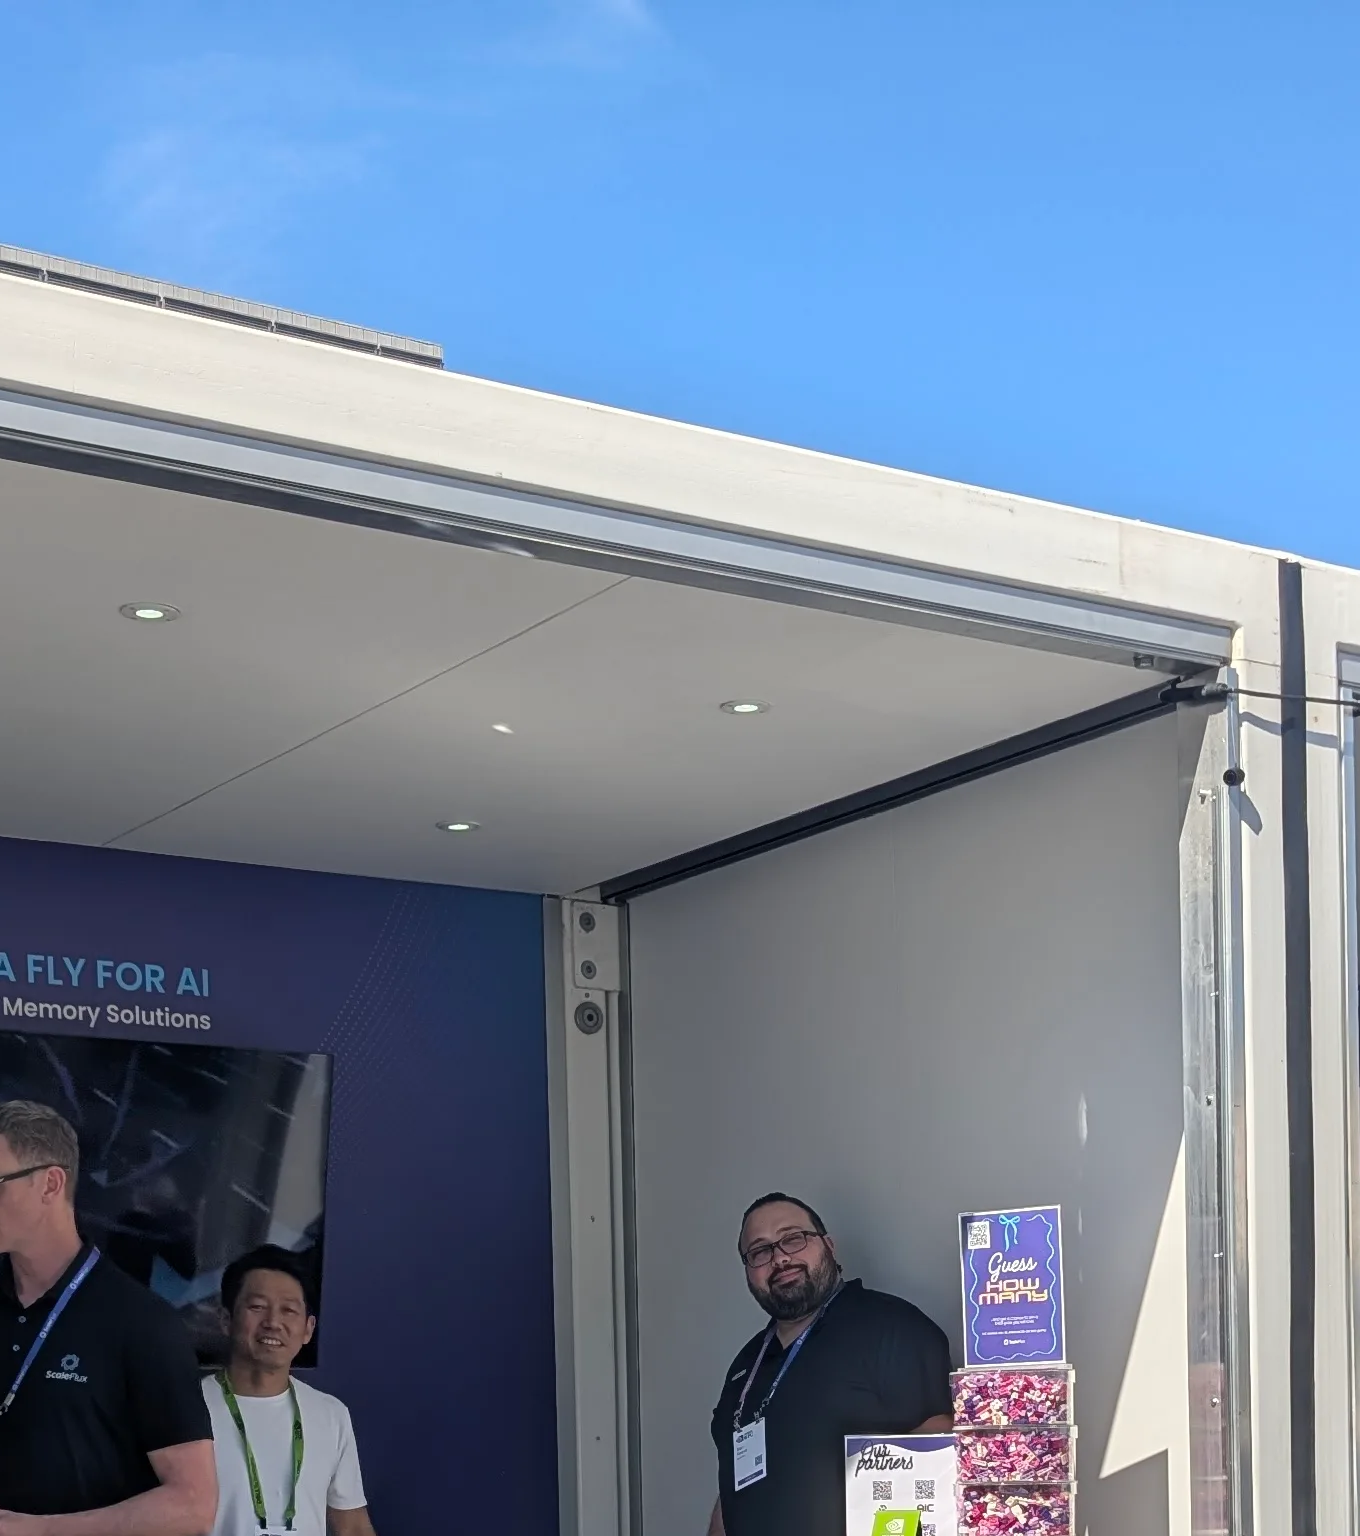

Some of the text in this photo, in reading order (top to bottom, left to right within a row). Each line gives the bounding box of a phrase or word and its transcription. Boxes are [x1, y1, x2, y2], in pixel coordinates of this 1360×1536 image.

[27, 953, 86, 987] FLY
[97, 959, 165, 994] FOR
[176, 965, 211, 997] AI
[3, 997, 100, 1030] Memory
[106, 1003, 212, 1031] Solutions
[988, 1252, 1038, 1282] Guess
[986, 1278, 1039, 1292] HOW
[861, 1440, 899, 1459] Our
[855, 1455, 914, 1478] partners
